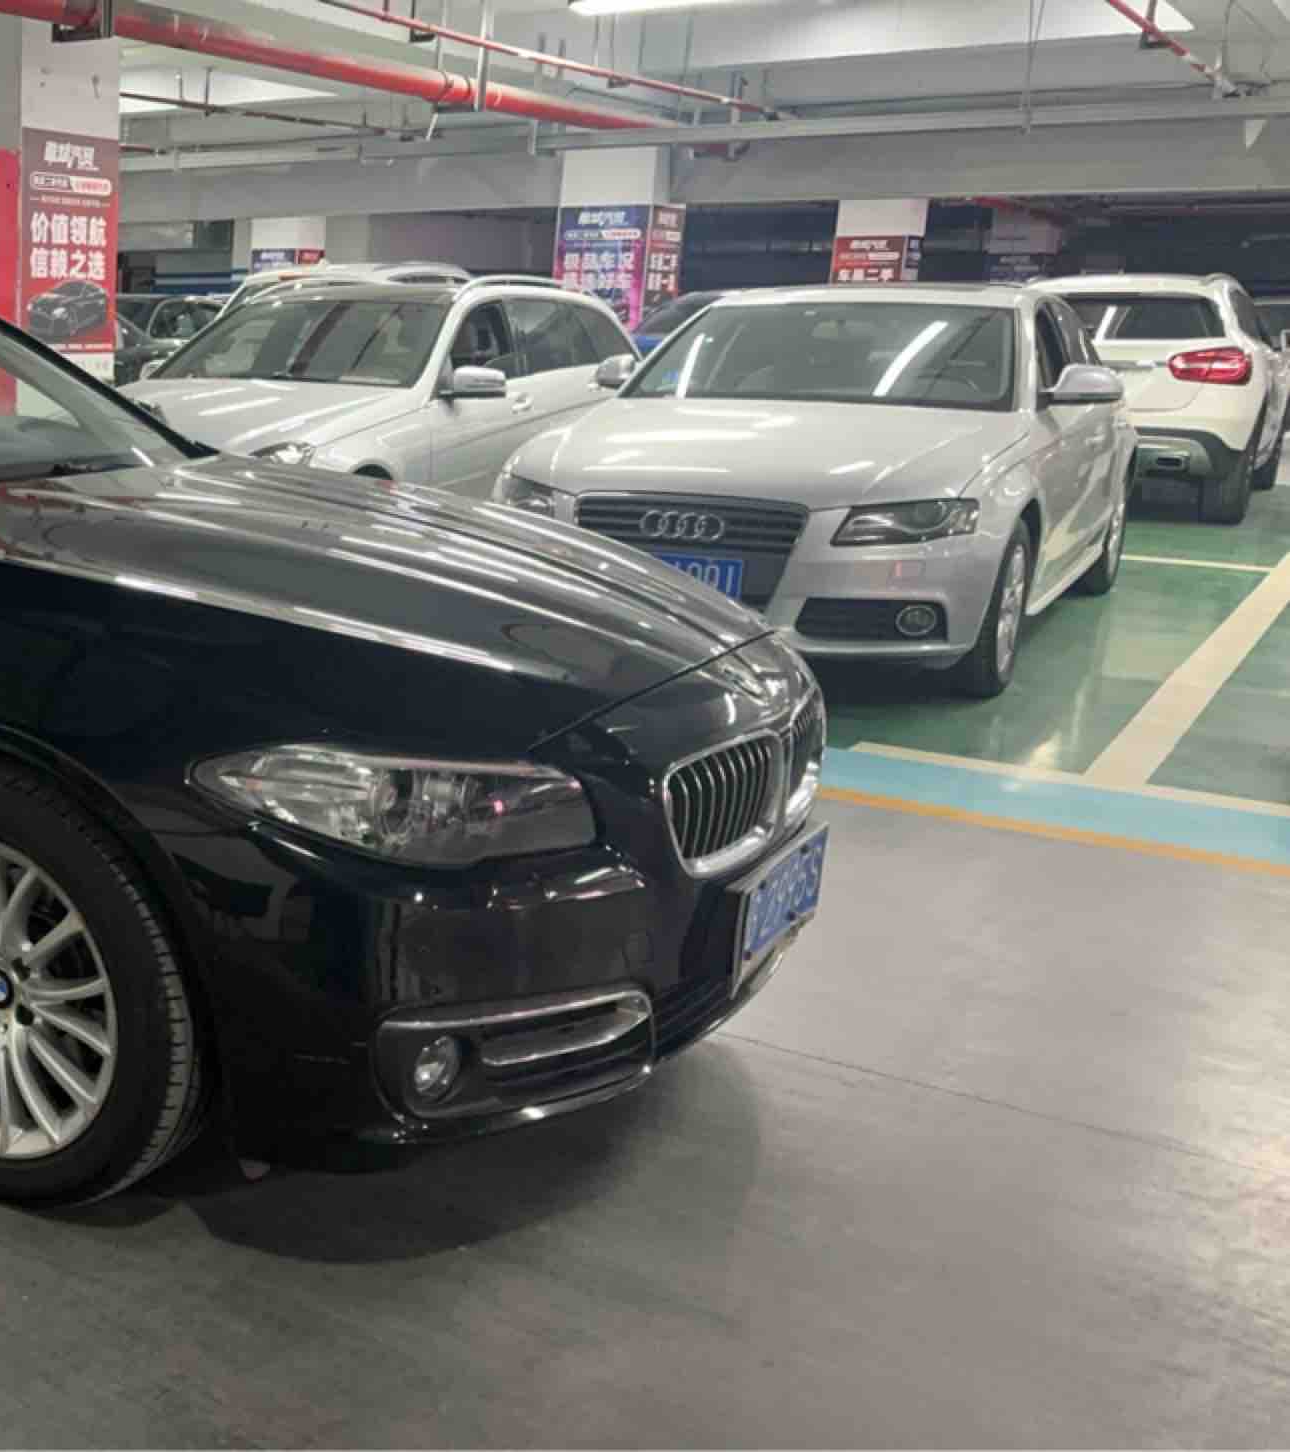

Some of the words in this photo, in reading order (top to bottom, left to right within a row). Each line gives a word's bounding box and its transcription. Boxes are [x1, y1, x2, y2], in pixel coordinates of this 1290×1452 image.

[31, 211, 108, 248] 价值领航
[30, 247, 106, 281] 信赖之选
